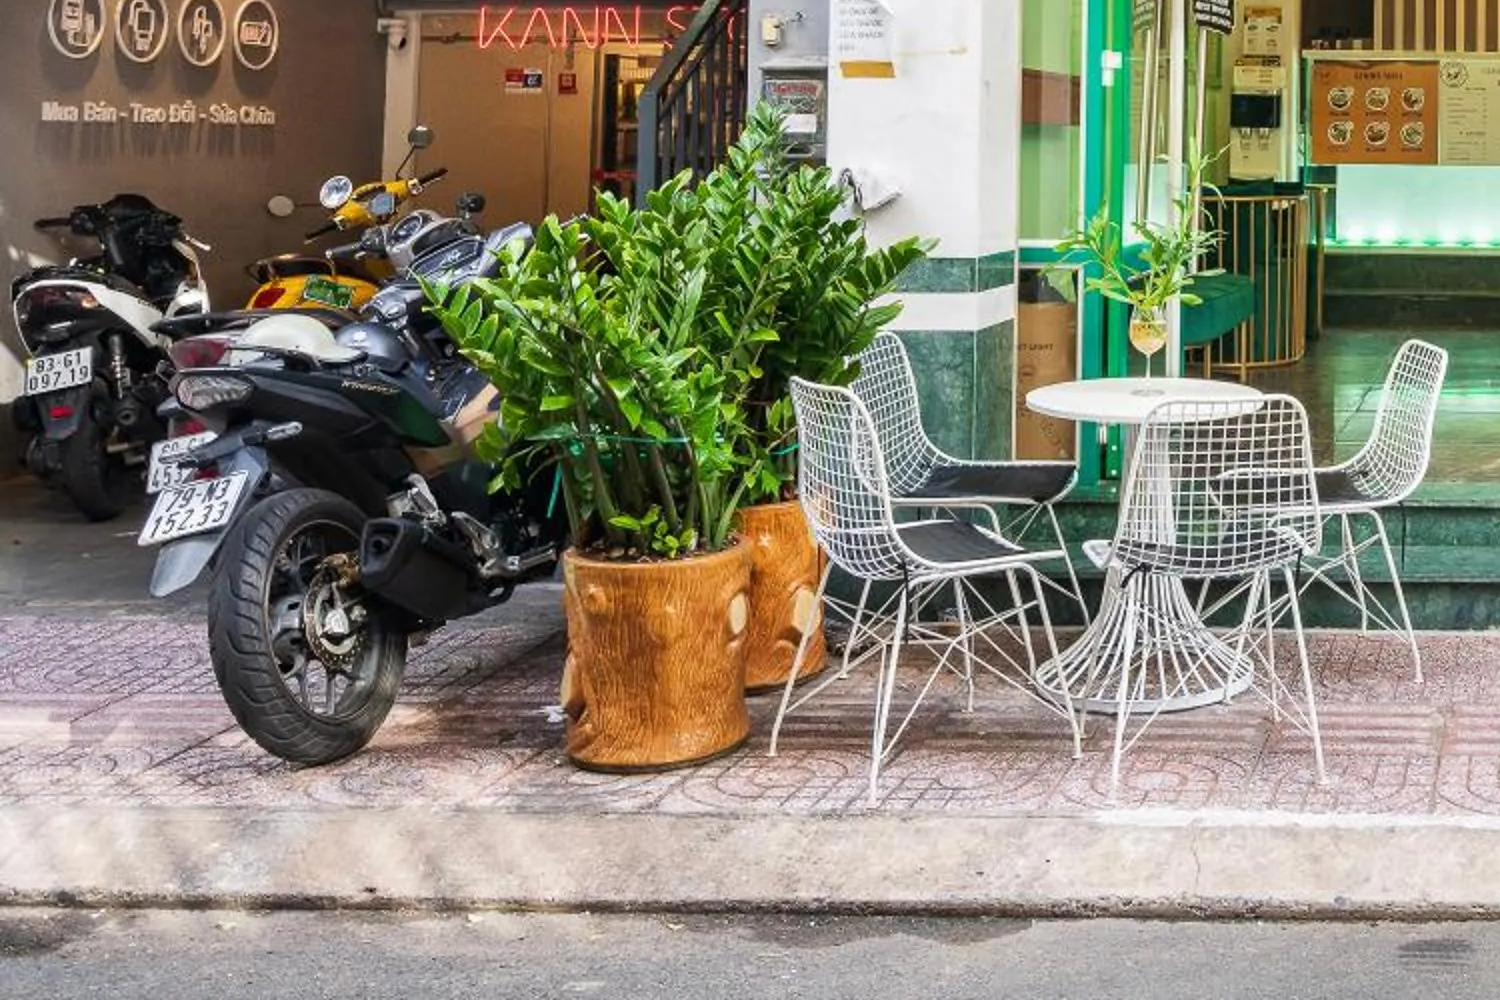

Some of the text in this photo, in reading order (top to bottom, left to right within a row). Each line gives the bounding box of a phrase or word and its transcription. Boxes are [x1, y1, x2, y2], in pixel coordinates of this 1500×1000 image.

[479, 5, 640, 49] KANN
[41, 102, 79, 122] Mua
[29, 365, 89, 391] 097.19
[150, 501, 229, 539] 152.33
